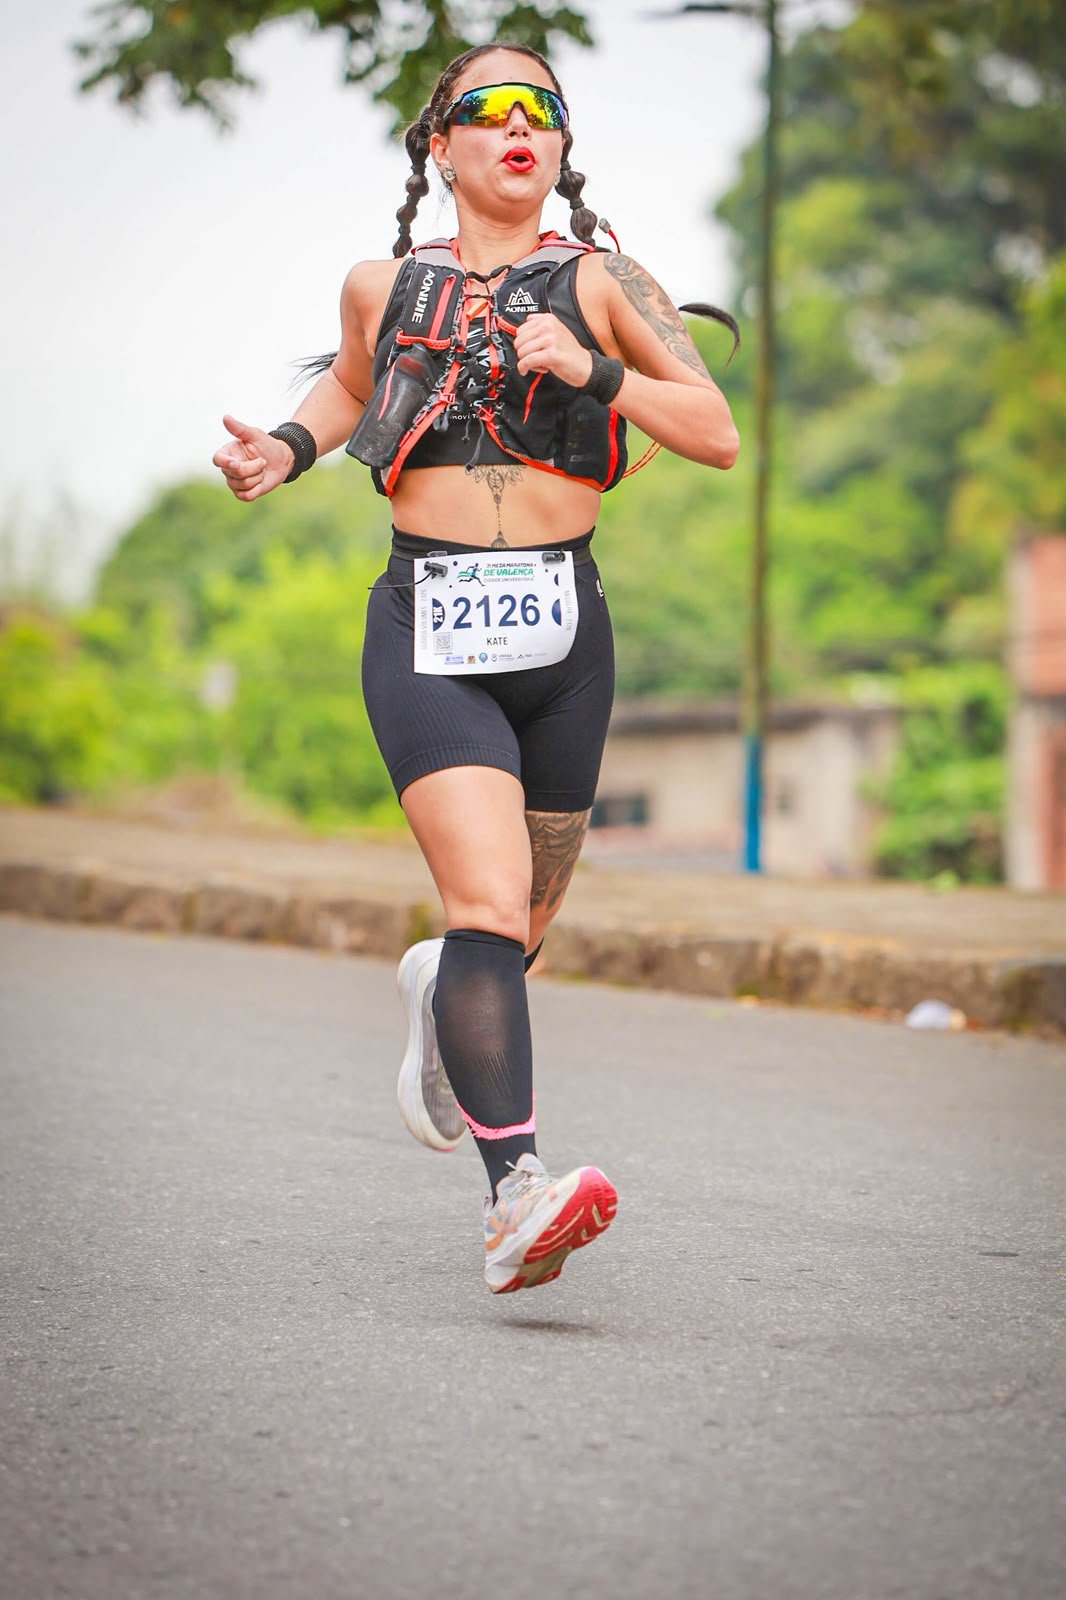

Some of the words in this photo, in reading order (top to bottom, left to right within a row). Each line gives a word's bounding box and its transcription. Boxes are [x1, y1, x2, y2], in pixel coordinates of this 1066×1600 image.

[411, 269, 436, 324] AONIJIE
[483, 569, 495, 577] DE
[496, 568, 534, 577] VALENÇA
[452, 593, 541, 630] 2126
[486, 637, 509, 646] KATE
